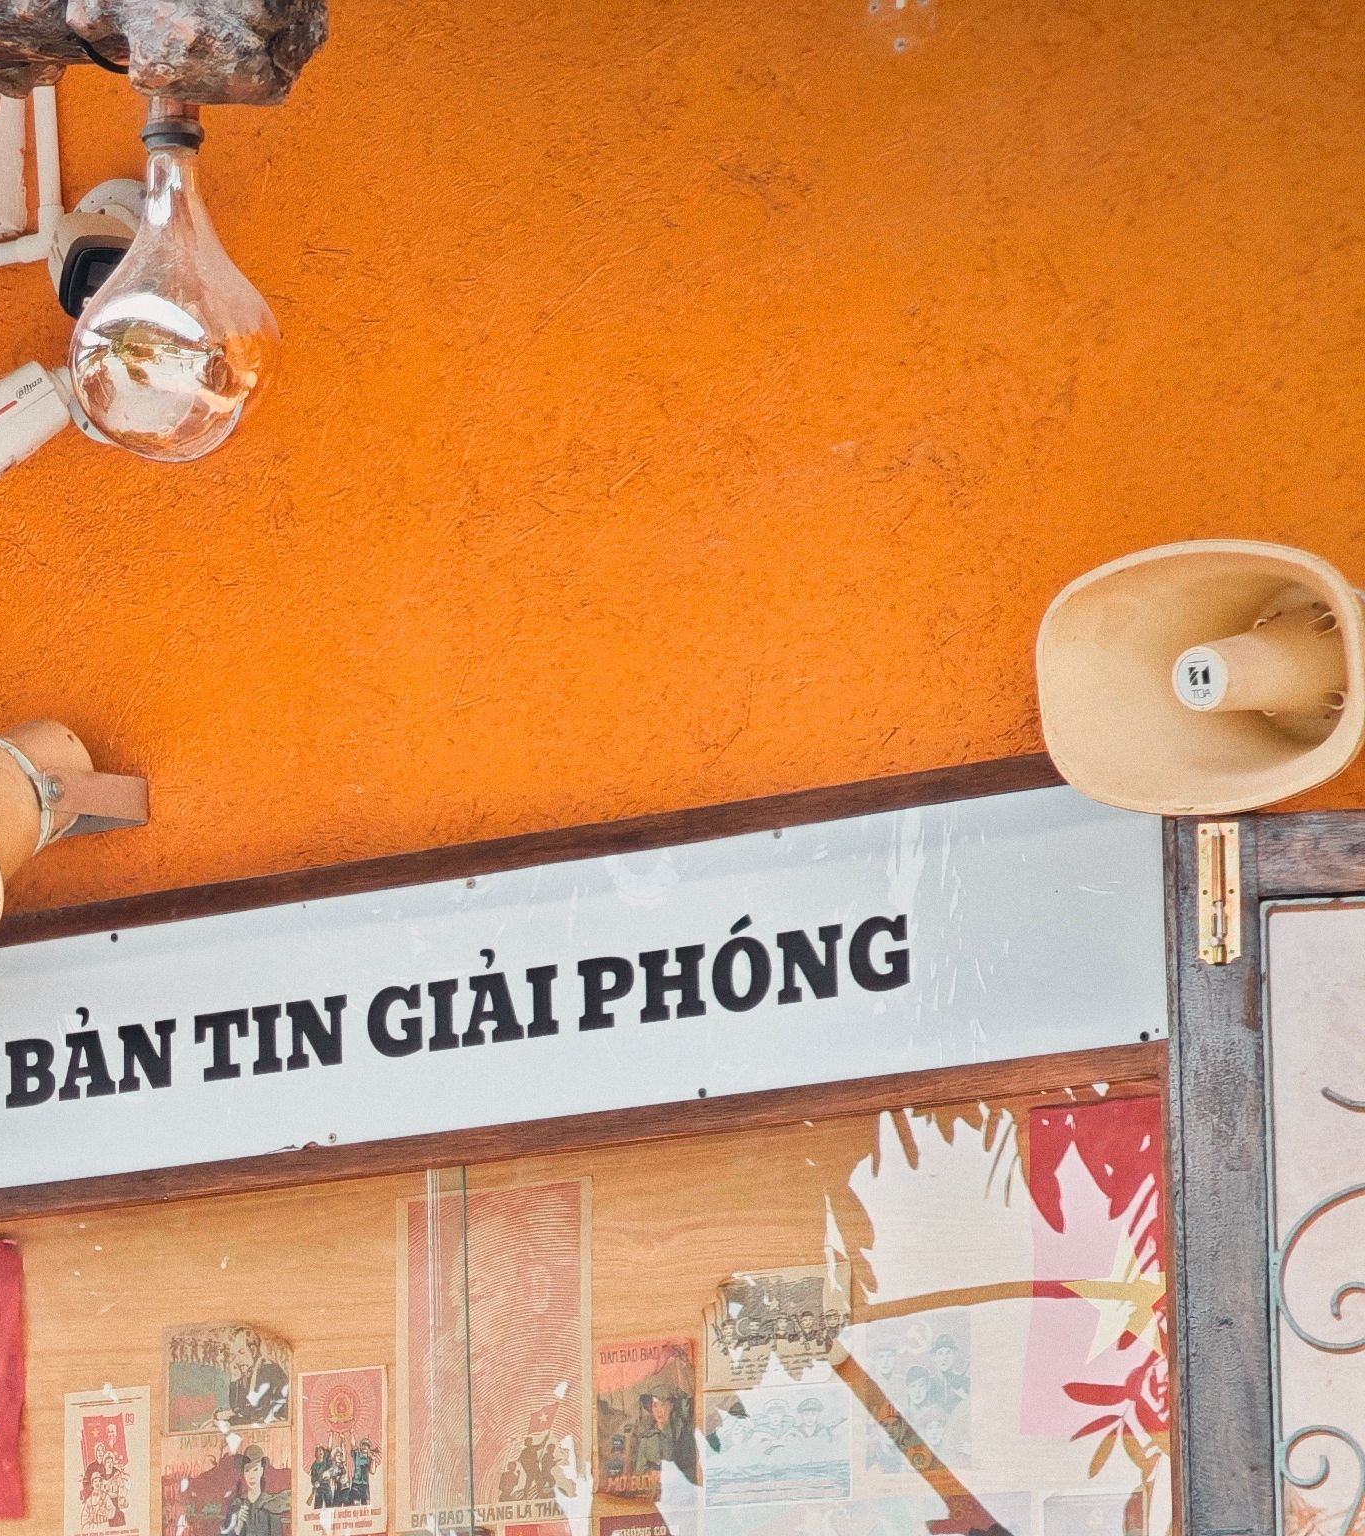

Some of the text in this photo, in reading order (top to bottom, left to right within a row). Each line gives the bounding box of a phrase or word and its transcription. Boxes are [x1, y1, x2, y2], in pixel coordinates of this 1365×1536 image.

[1191, 688, 1211, 699] TOA
[4, 914, 911, 1112] BẢN TIN GIẢI PHÓNG
